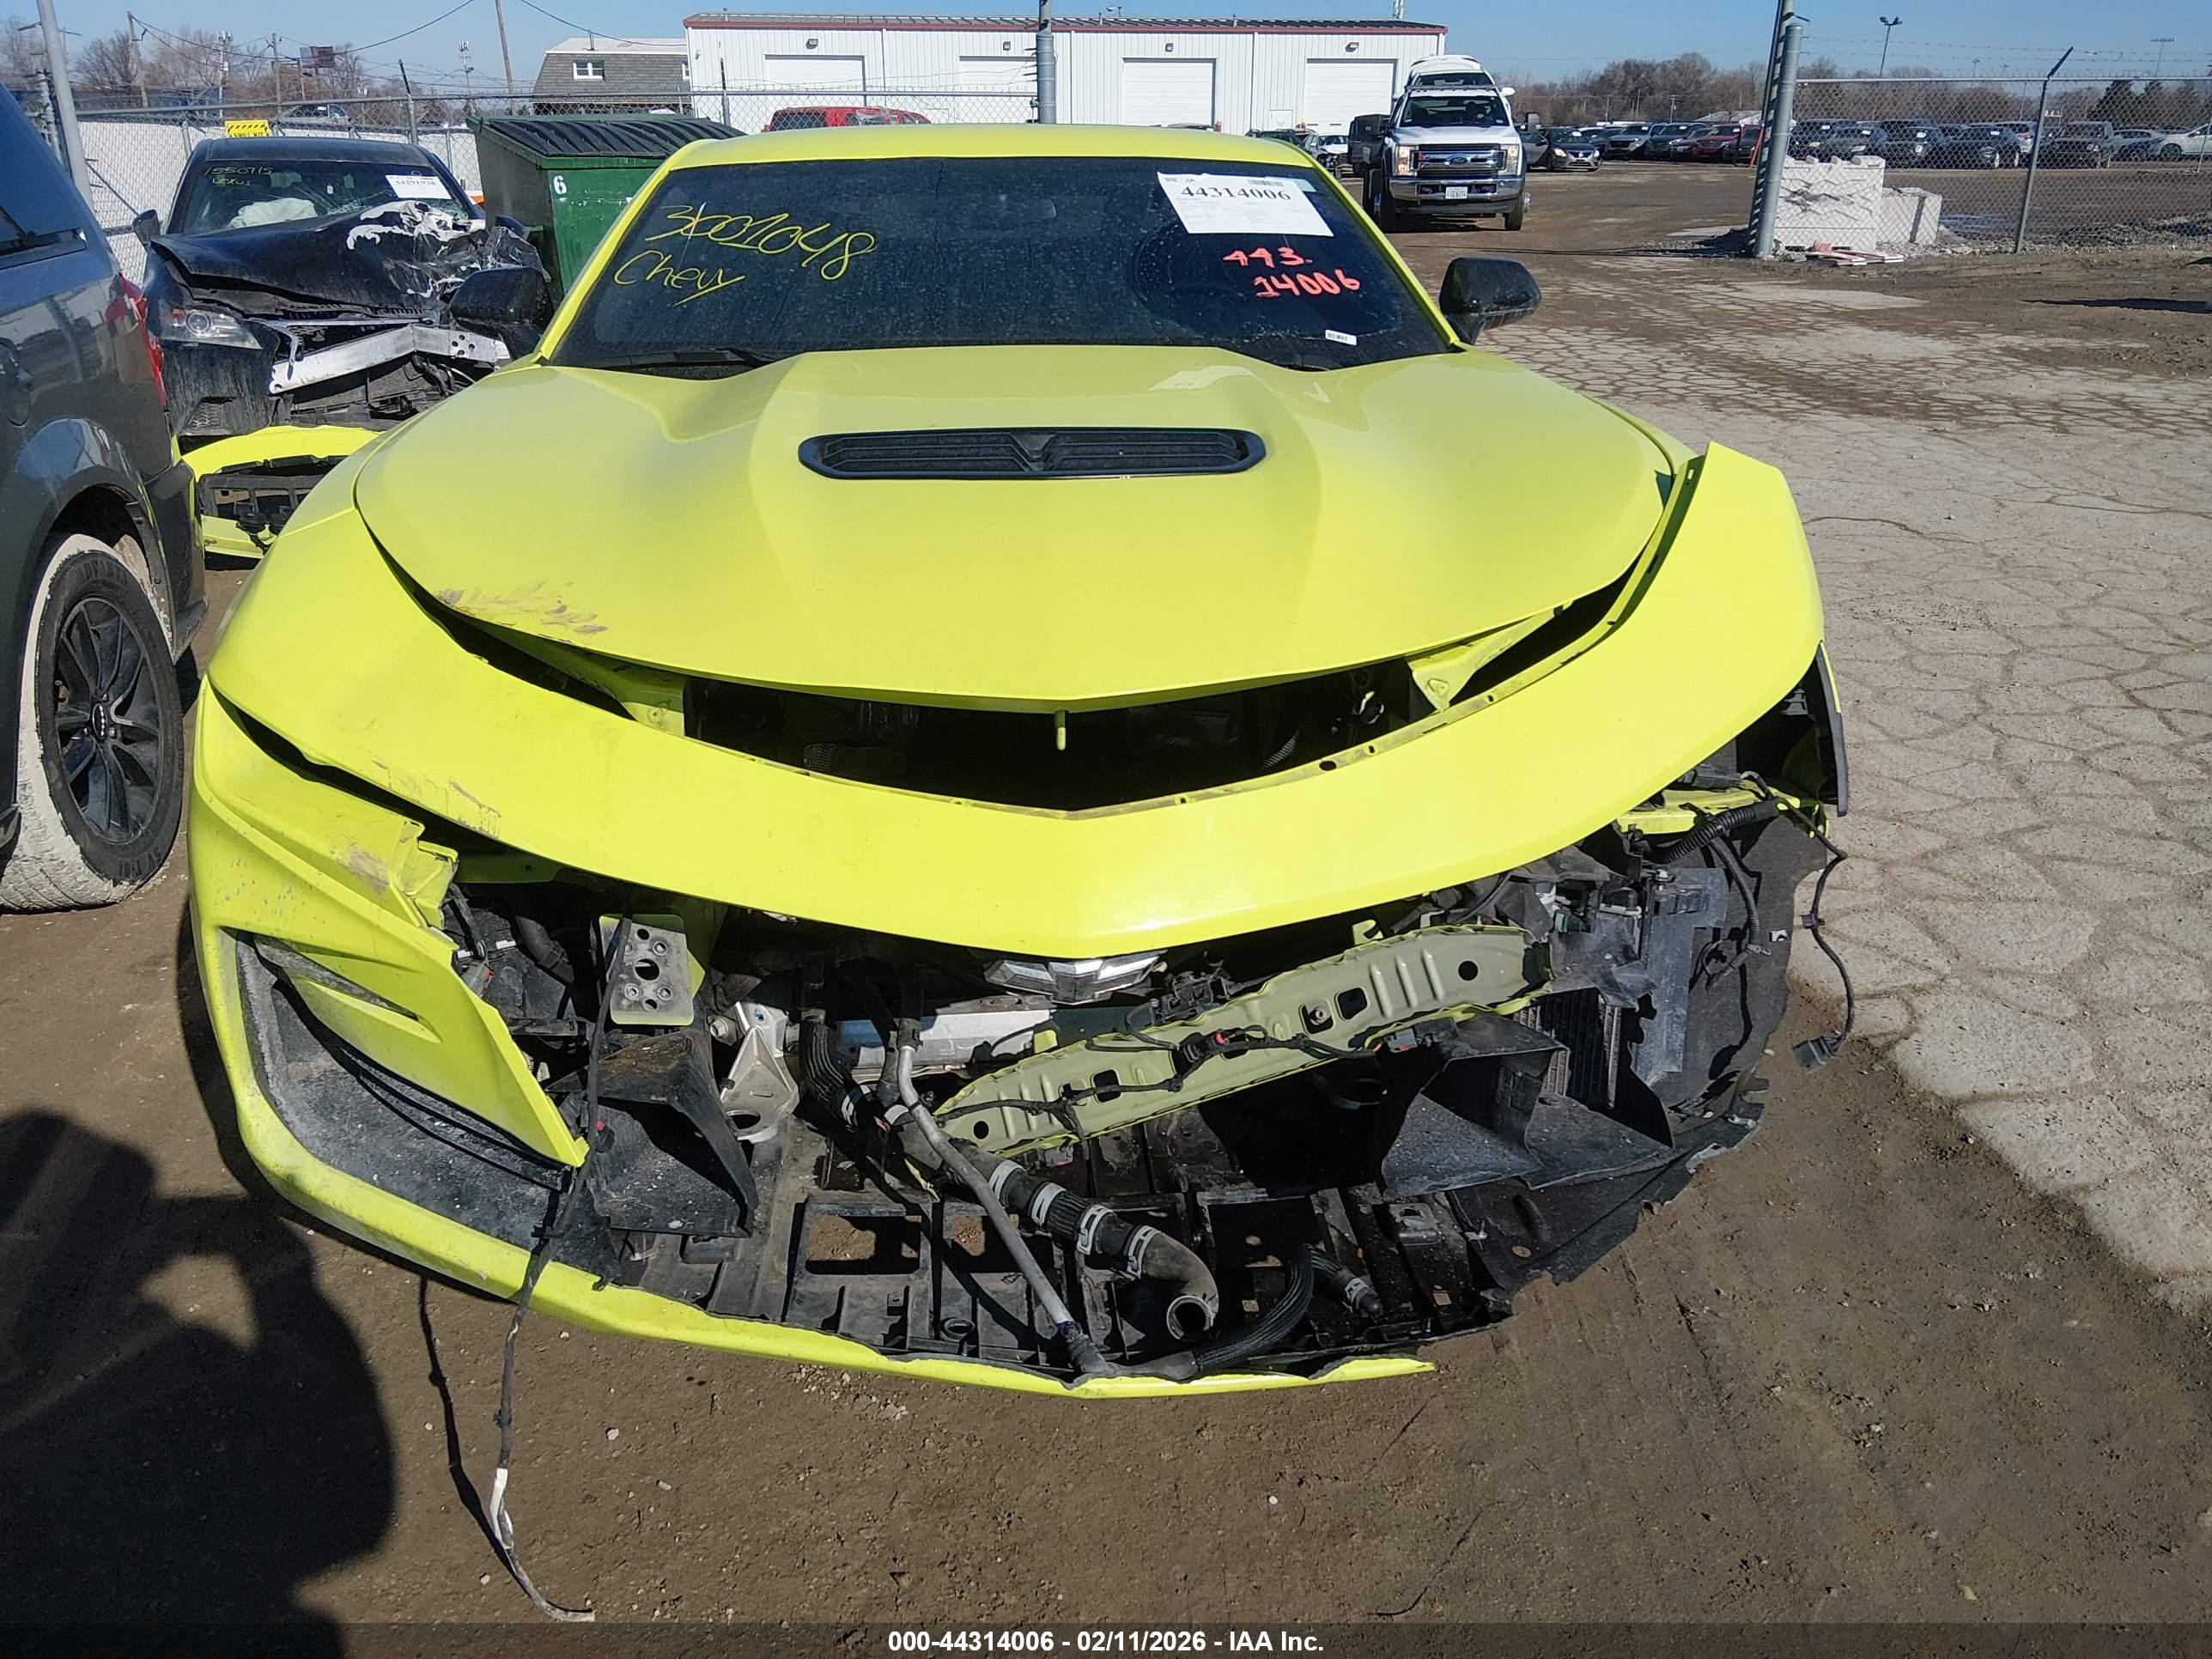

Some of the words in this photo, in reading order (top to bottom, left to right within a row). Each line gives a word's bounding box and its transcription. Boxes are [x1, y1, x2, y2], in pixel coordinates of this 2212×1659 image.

[553, 174, 568, 195] 6
[1181, 185, 1291, 201] 44314006
[1253, 268, 1361, 297] 14006
